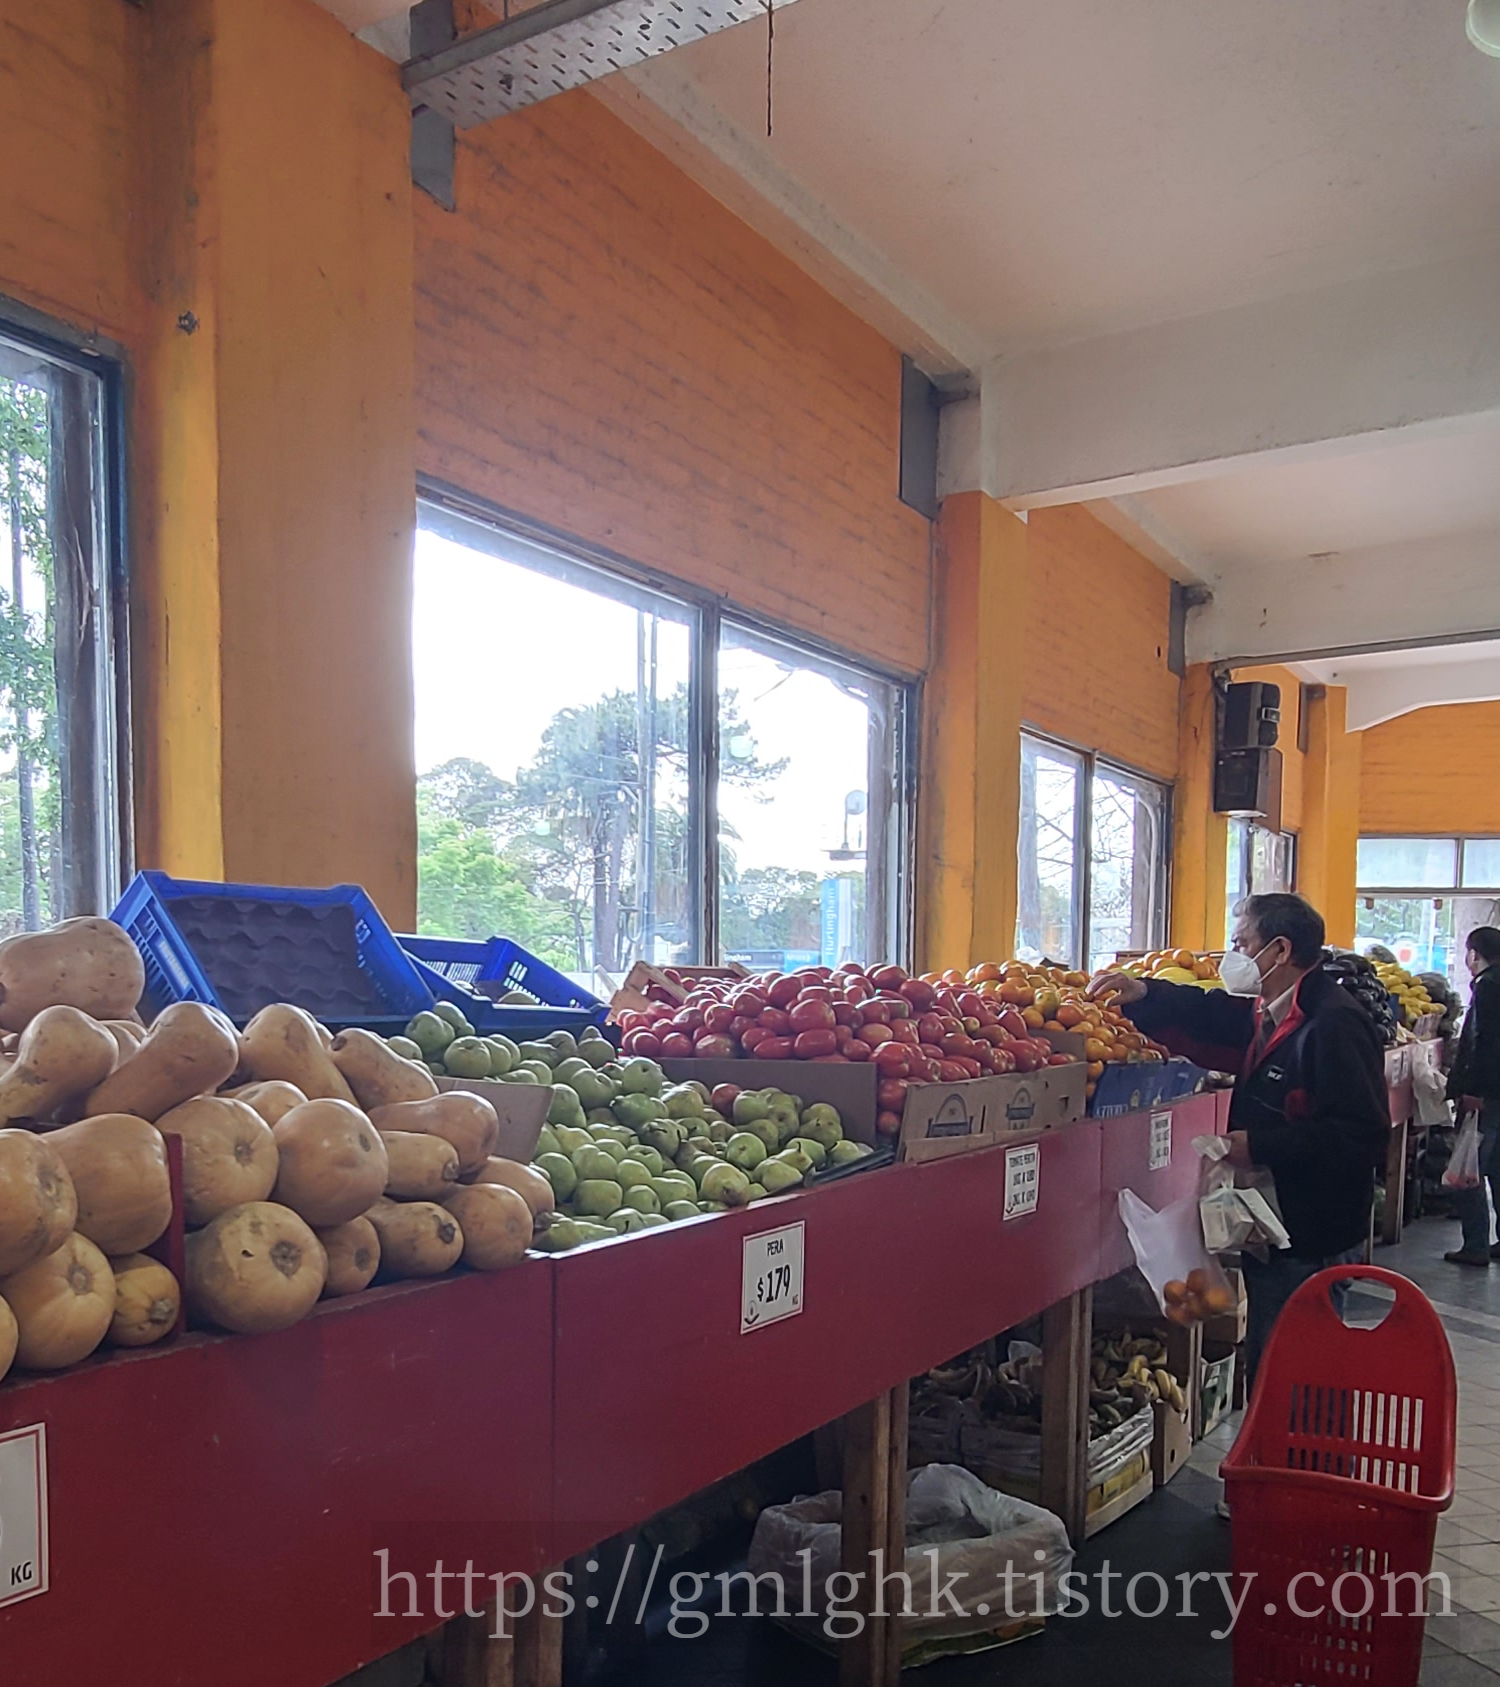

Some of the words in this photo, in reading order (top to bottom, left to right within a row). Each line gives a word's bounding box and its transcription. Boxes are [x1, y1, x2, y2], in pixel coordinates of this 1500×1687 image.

[824, 887, 838, 956] Hurlingham
[766, 1238, 784, 1257] PERA
[757, 1264, 791, 1303] $179
[11, 1561, 33, 1586] KG
